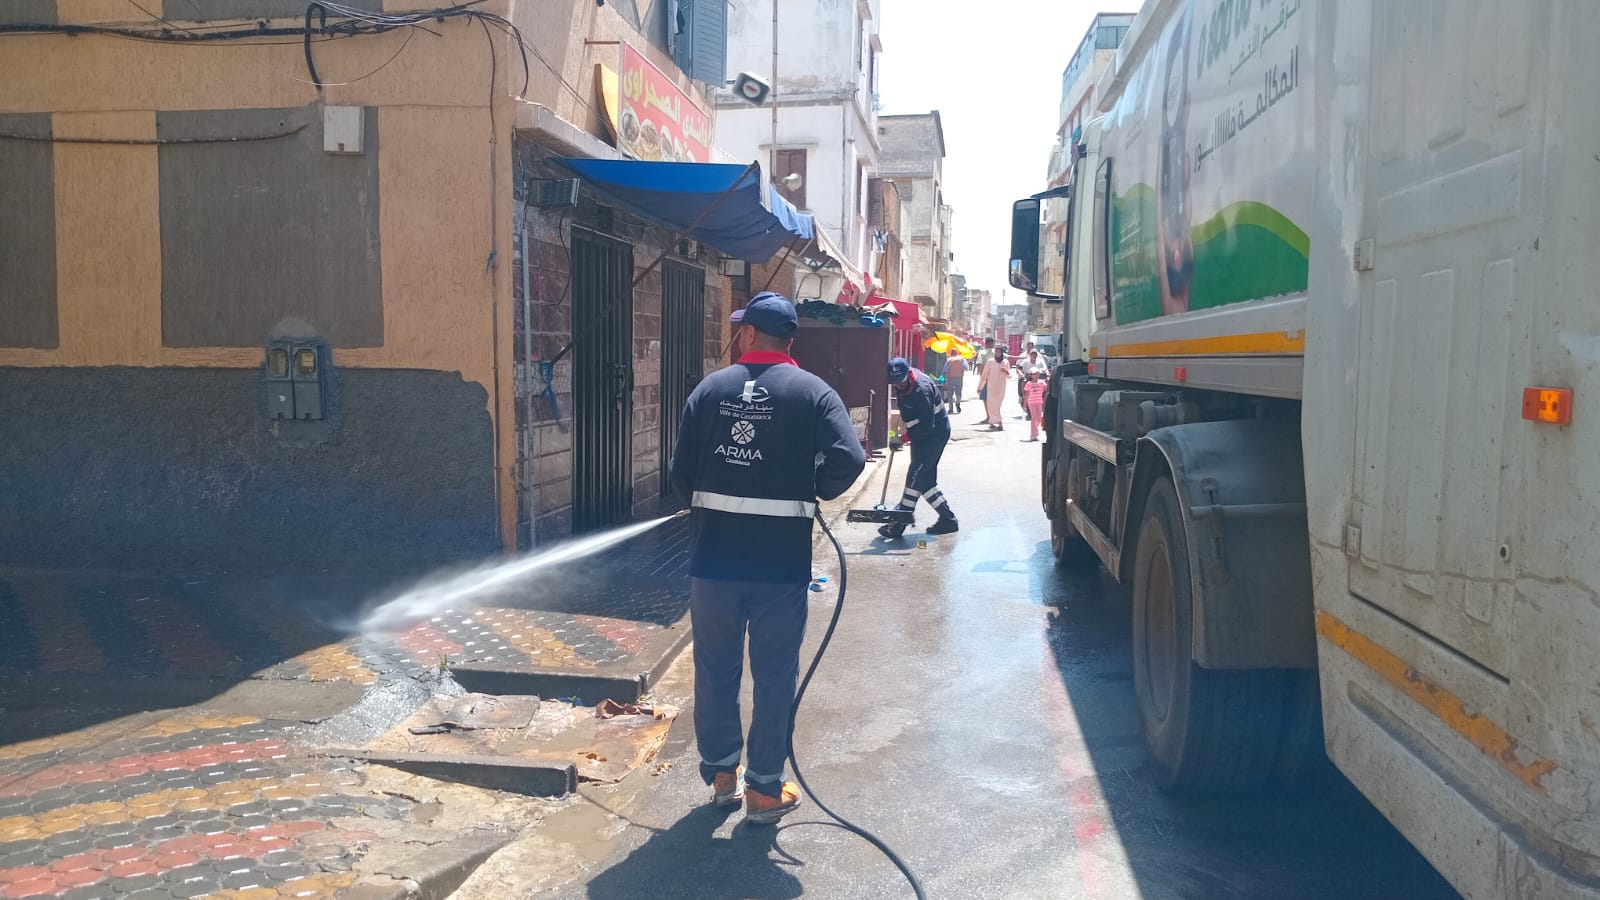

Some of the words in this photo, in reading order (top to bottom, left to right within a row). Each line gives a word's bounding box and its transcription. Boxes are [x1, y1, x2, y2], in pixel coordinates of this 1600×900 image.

[740, 412, 772, 420] Casablanca
[715, 444, 762, 460] ARMA
[725, 457, 750, 466] Casablanca
